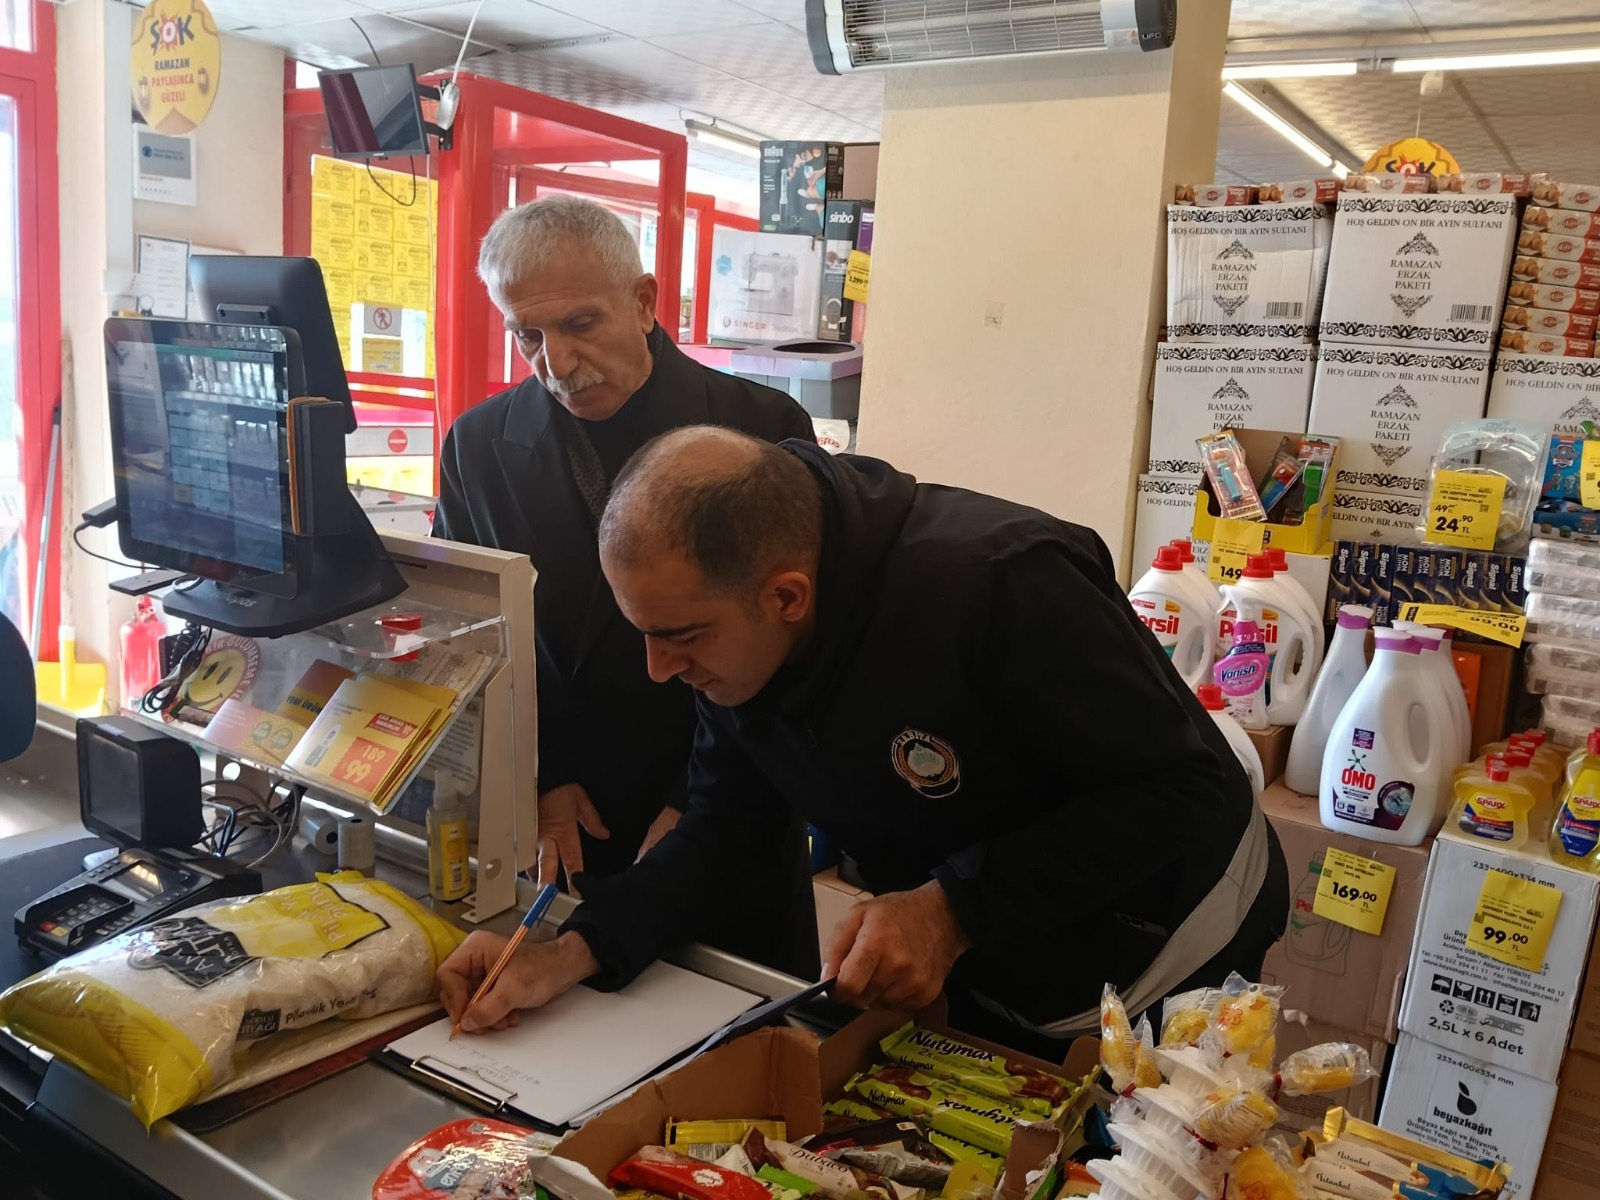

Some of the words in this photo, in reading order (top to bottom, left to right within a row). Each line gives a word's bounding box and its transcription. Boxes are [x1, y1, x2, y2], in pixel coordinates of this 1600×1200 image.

[150, 14, 195, 57] ŞOK
[1142, 32, 1162, 40] UFO
[154, 58, 190, 71] RAMAZAN
[828, 211, 854, 224] sinbo
[1346, 218, 1365, 228] HOŞ
[1366, 218, 1401, 227] GELDİN
[1402, 219, 1417, 227] ON
[1419, 219, 1435, 228] BİR
[1437, 219, 1460, 228] AYIN
[1462, 220, 1503, 229] SULTANI
[1171, 227, 1188, 237] HOŞ
[1189, 227, 1219, 236] GELDİN
[1234, 227, 1248, 236] BİR
[1250, 227, 1270, 235] AYIN
[1271, 226, 1307, 235] SULTANI
[1211, 263, 1257, 272] RAMAZAN
[1390, 259, 1442, 269] RAMAZAN
[1218, 273, 1248, 281] ERZAK
[1397, 270, 1431, 279] ERZAK
[733, 320, 767, 330] SINGER
[1166, 365, 1182, 375] HOŞ
[1184, 365, 1214, 374] GELDİN
[1216, 366, 1229, 374] ON
[1230, 365, 1244, 374] BİR
[1245, 366, 1267, 374] AYIN
[1268, 366, 1303, 375] SULTANI
[1326, 367, 1345, 377] HOŞ
[1346, 368, 1380, 379] GELDİN
[1399, 371, 1414, 381] BİR
[1415, 374, 1439, 382] AYIN
[1440, 375, 1480, 386] SULTANI
[1505, 378, 1525, 389] HOŞ
[1527, 379, 1564, 391] GELDİN
[1566, 383, 1583, 391] ON
[1207, 404, 1253, 412] RAMAZAN
[1214, 413, 1244, 421] ERZAK
[1370, 410, 1421, 422] RAMAZAN
[1377, 421, 1411, 431] ERZAK
[1553, 423, 1586, 434] RAMA
[1146, 497, 1163, 506] HOŞ
[1163, 498, 1193, 507] GELDİN
[1331, 512, 1359, 522] ELDİN
[1360, 516, 1375, 524] ON
[1376, 517, 1391, 526] BİR
[1392, 521, 1415, 529] AYIN
[1462, 526, 1470, 534] TL
[1192, 546, 1209, 555] ERZ
[1338, 548, 1349, 574] Signal
[1358, 550, 1369, 576] Signal
[1379, 552, 1390, 578] Signal
[1401, 553, 1409, 572] NOW
[1466, 561, 1477, 588] Signal
[1488, 563, 1500, 590] Signal
[1511, 565, 1522, 592] Signal
[1134, 613, 1180, 635] ersil
[1220, 619, 1278, 644] Psil
[1221, 664, 1256, 682] Vanish
[896, 731, 931, 747] ZABITA
[1341, 768, 1377, 791] OMO
[1538, 877, 1556, 889] mm
[1362, 901, 1370, 909] TL
[1454, 929, 1468, 939] Bey
[1512, 943, 1520, 951] TL
[1428, 1016, 1460, 1035] 2,5L
[1461, 1029, 1471, 1039] x
[1474, 1031, 1484, 1043] 6
[1487, 1035, 1525, 1056] Adet
[908, 1031, 996, 1063] Nutymax
[899, 1055, 935, 1072] Nutymax
[1497, 1076, 1515, 1087] mm
[868, 1089, 907, 1106] Nutymax
[938, 1099, 1018, 1130] utymax
[1406, 1118, 1433, 1134] Ürünler
[1432, 1106, 1494, 1137] beyazkağıt
[1417, 1116, 1439, 1130] Beyaz
[1439, 1123, 1459, 1138] Kağıt
[1459, 1133, 1468, 1141] ve
